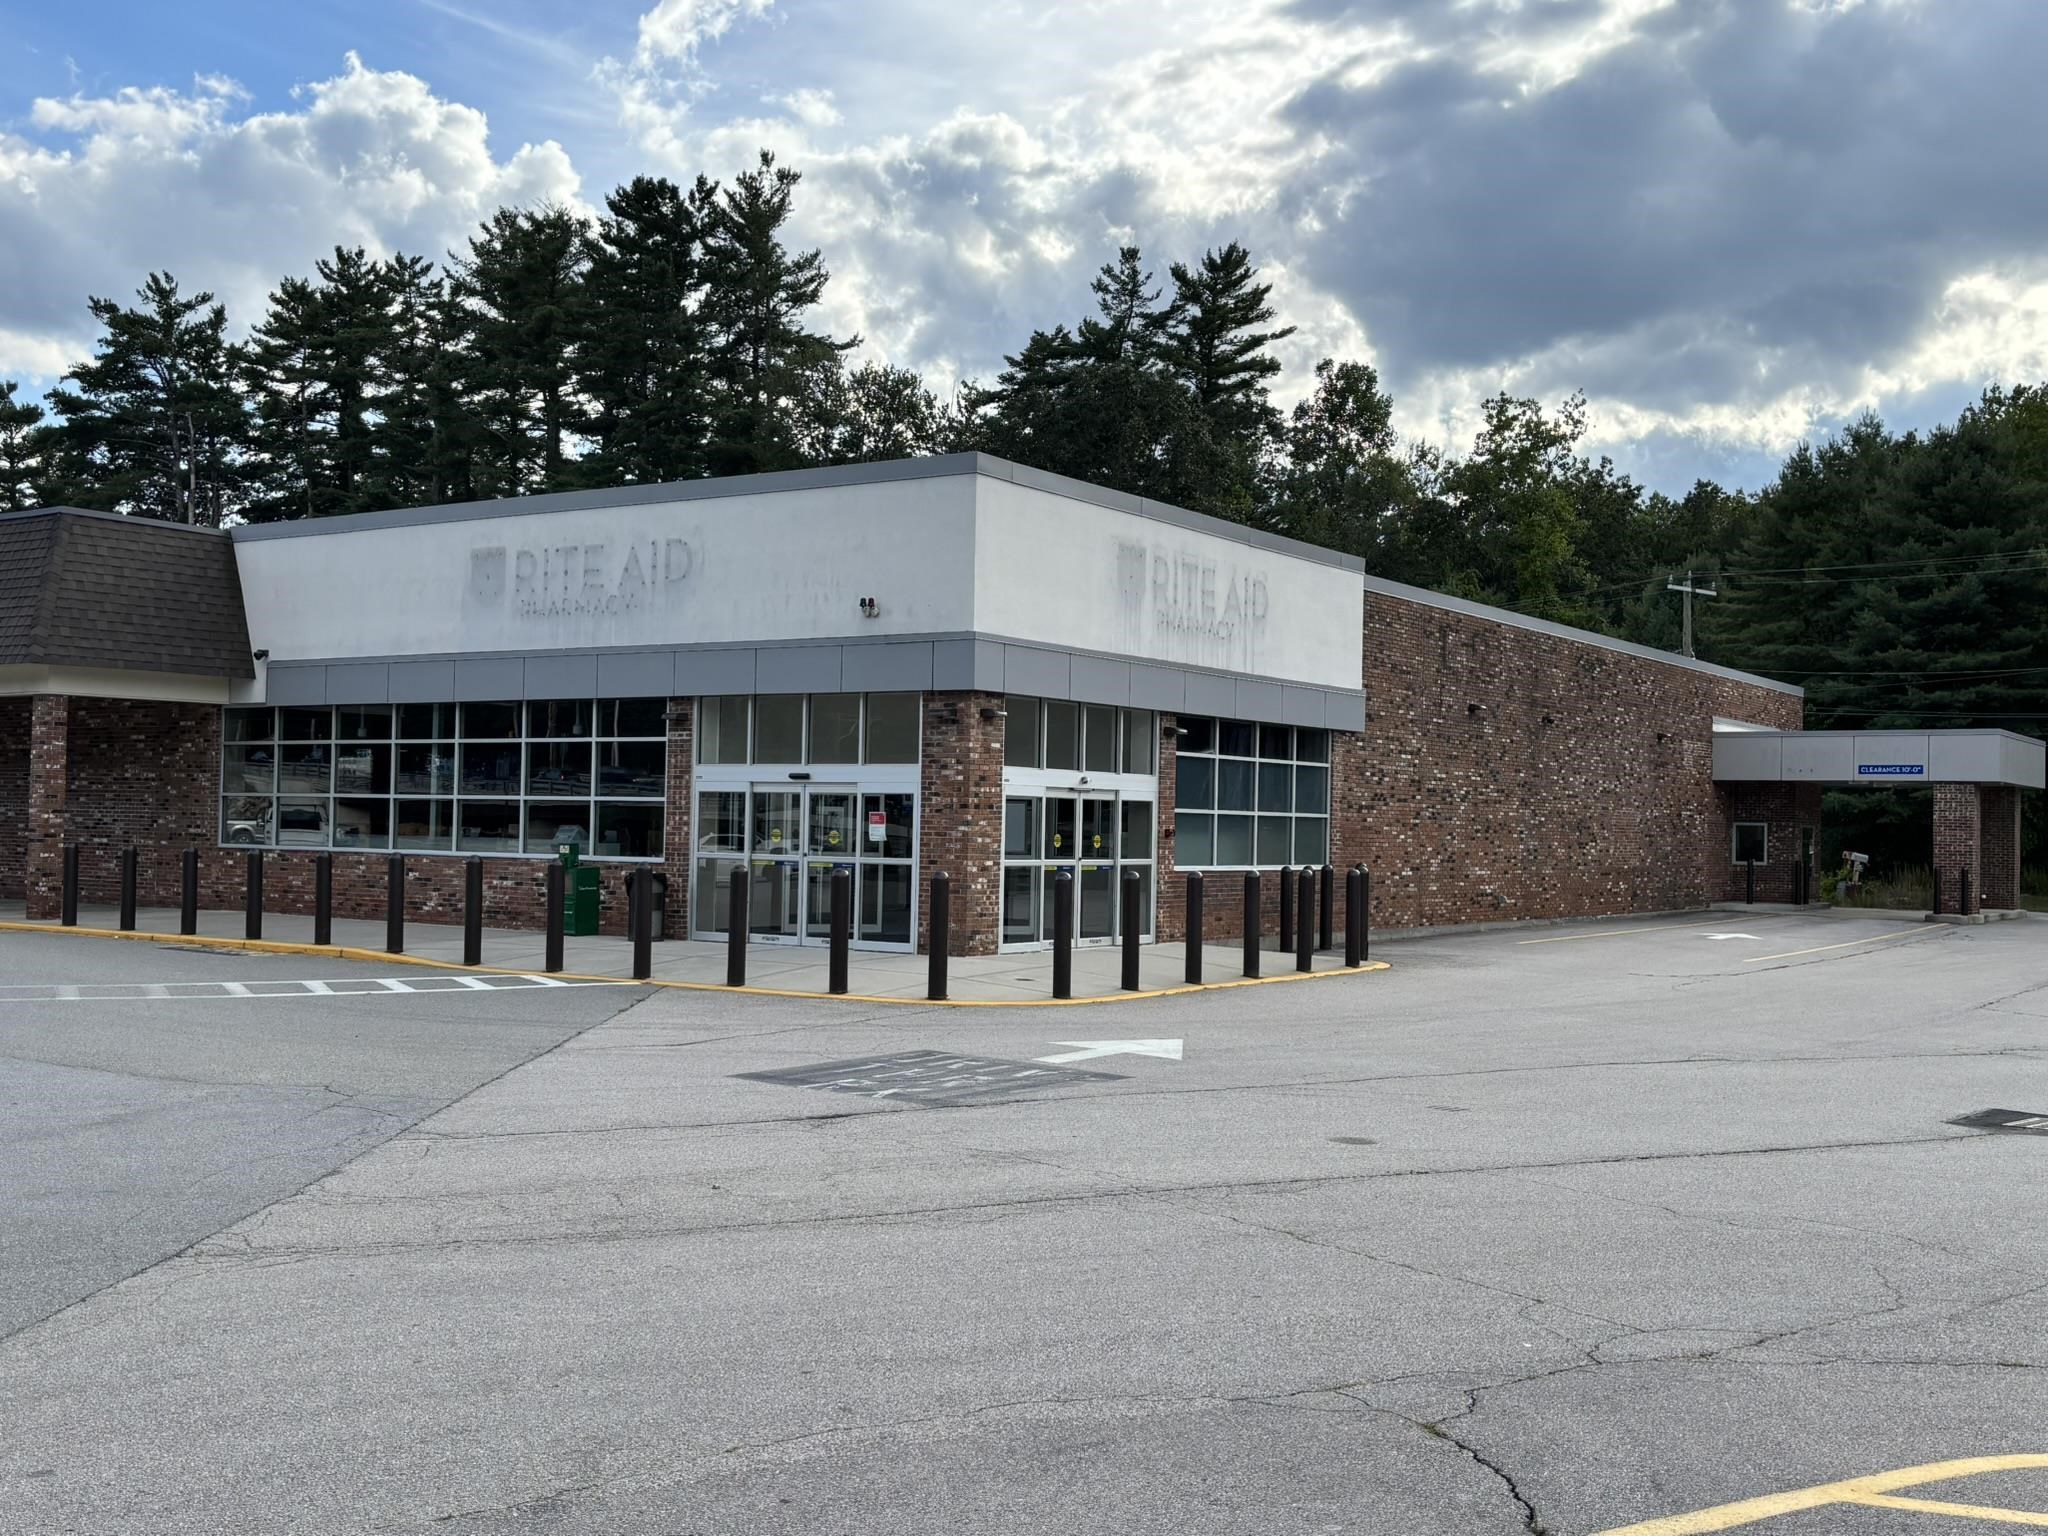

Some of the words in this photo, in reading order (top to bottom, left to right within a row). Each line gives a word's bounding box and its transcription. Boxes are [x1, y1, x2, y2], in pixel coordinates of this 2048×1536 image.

[515, 544, 605, 593] RITE
[617, 538, 694, 586] AID
[1153, 554, 1216, 609] RITE
[1223, 573, 1269, 619] AID
